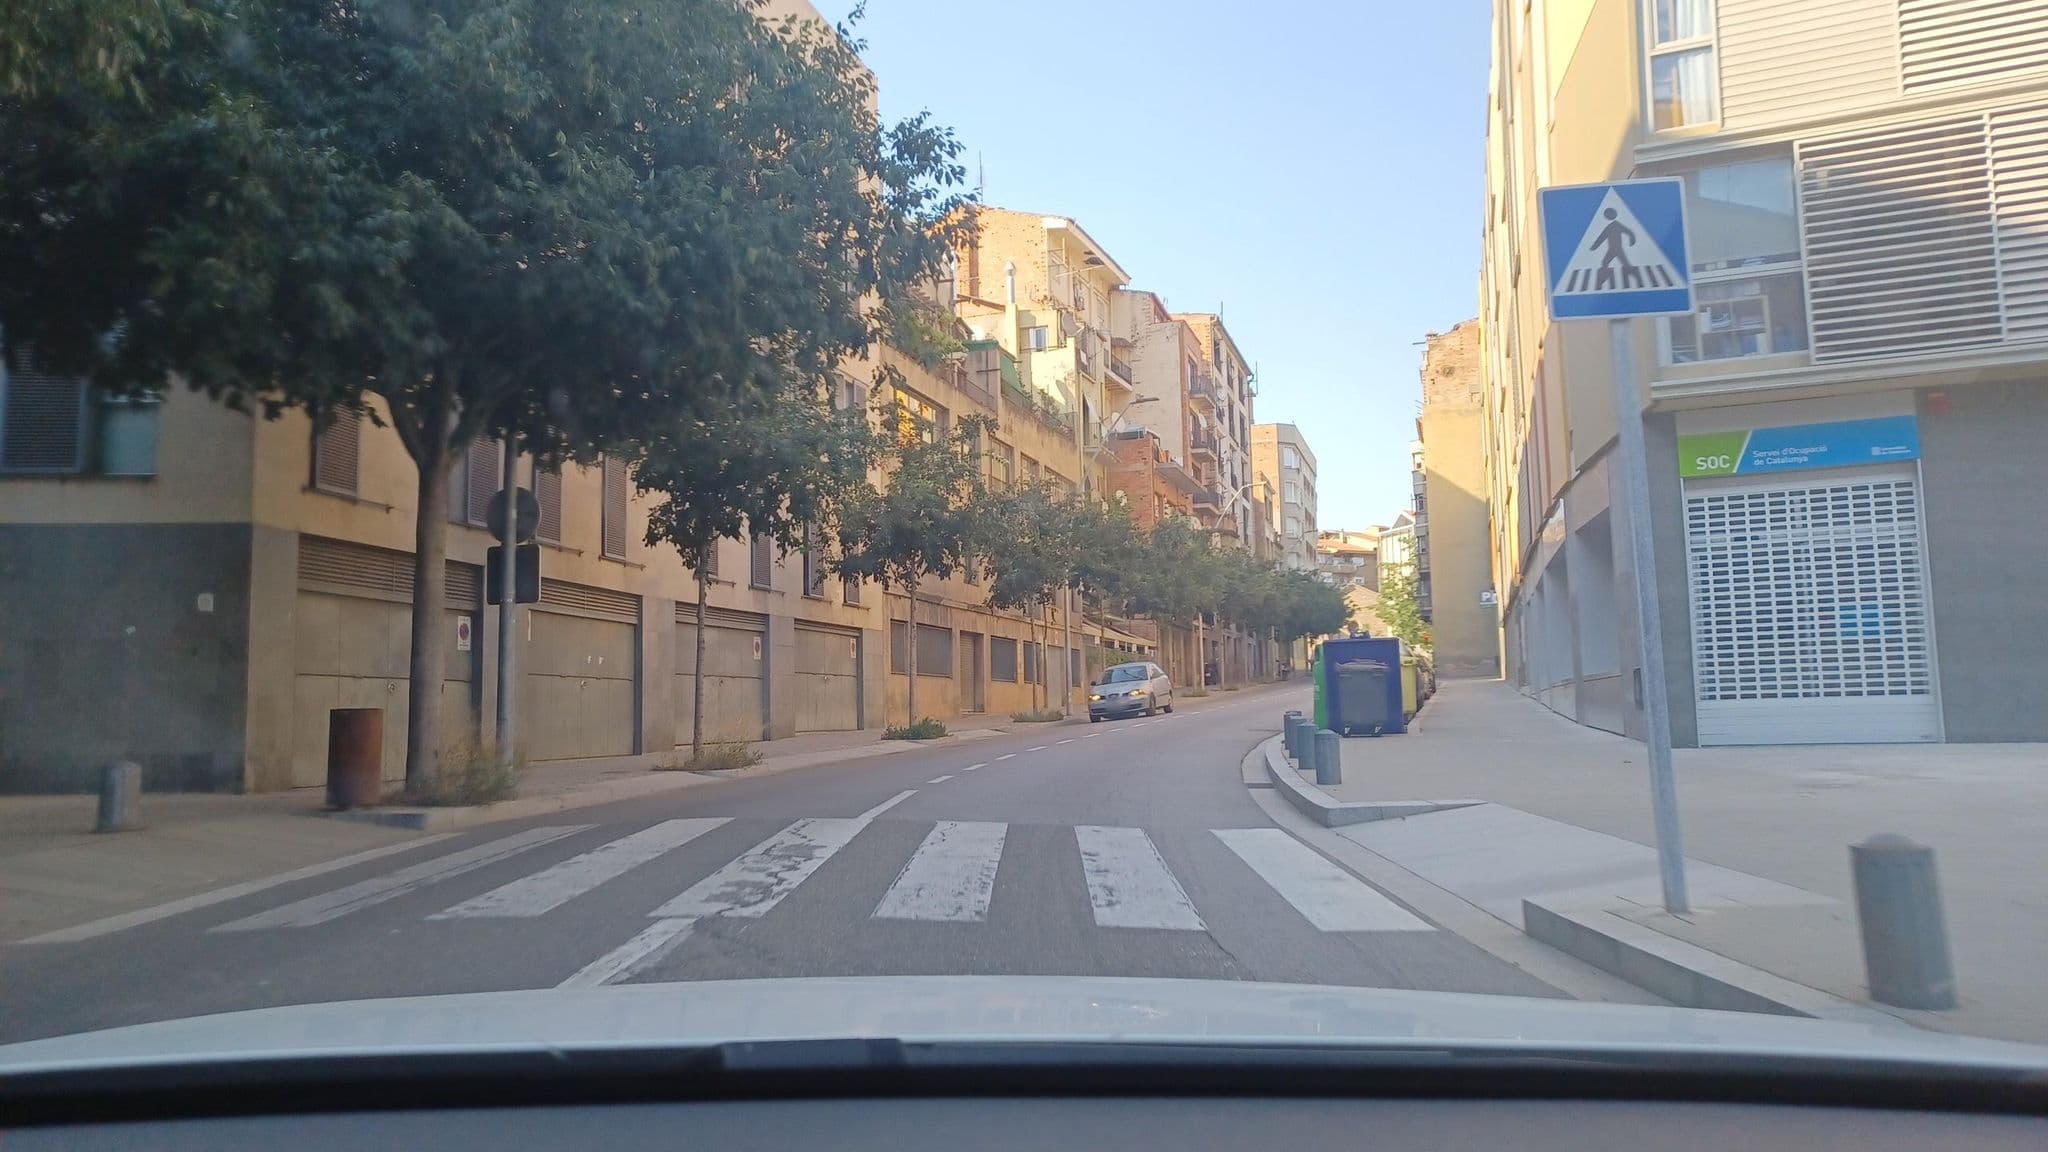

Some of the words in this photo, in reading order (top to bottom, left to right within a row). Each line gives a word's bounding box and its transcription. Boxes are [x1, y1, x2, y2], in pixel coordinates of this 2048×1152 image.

[1752, 449, 1780, 458] Servei
[1696, 455, 1730, 470] SOC
[1753, 458, 1765, 466] de
[1766, 455, 1809, 465] Catalunya
